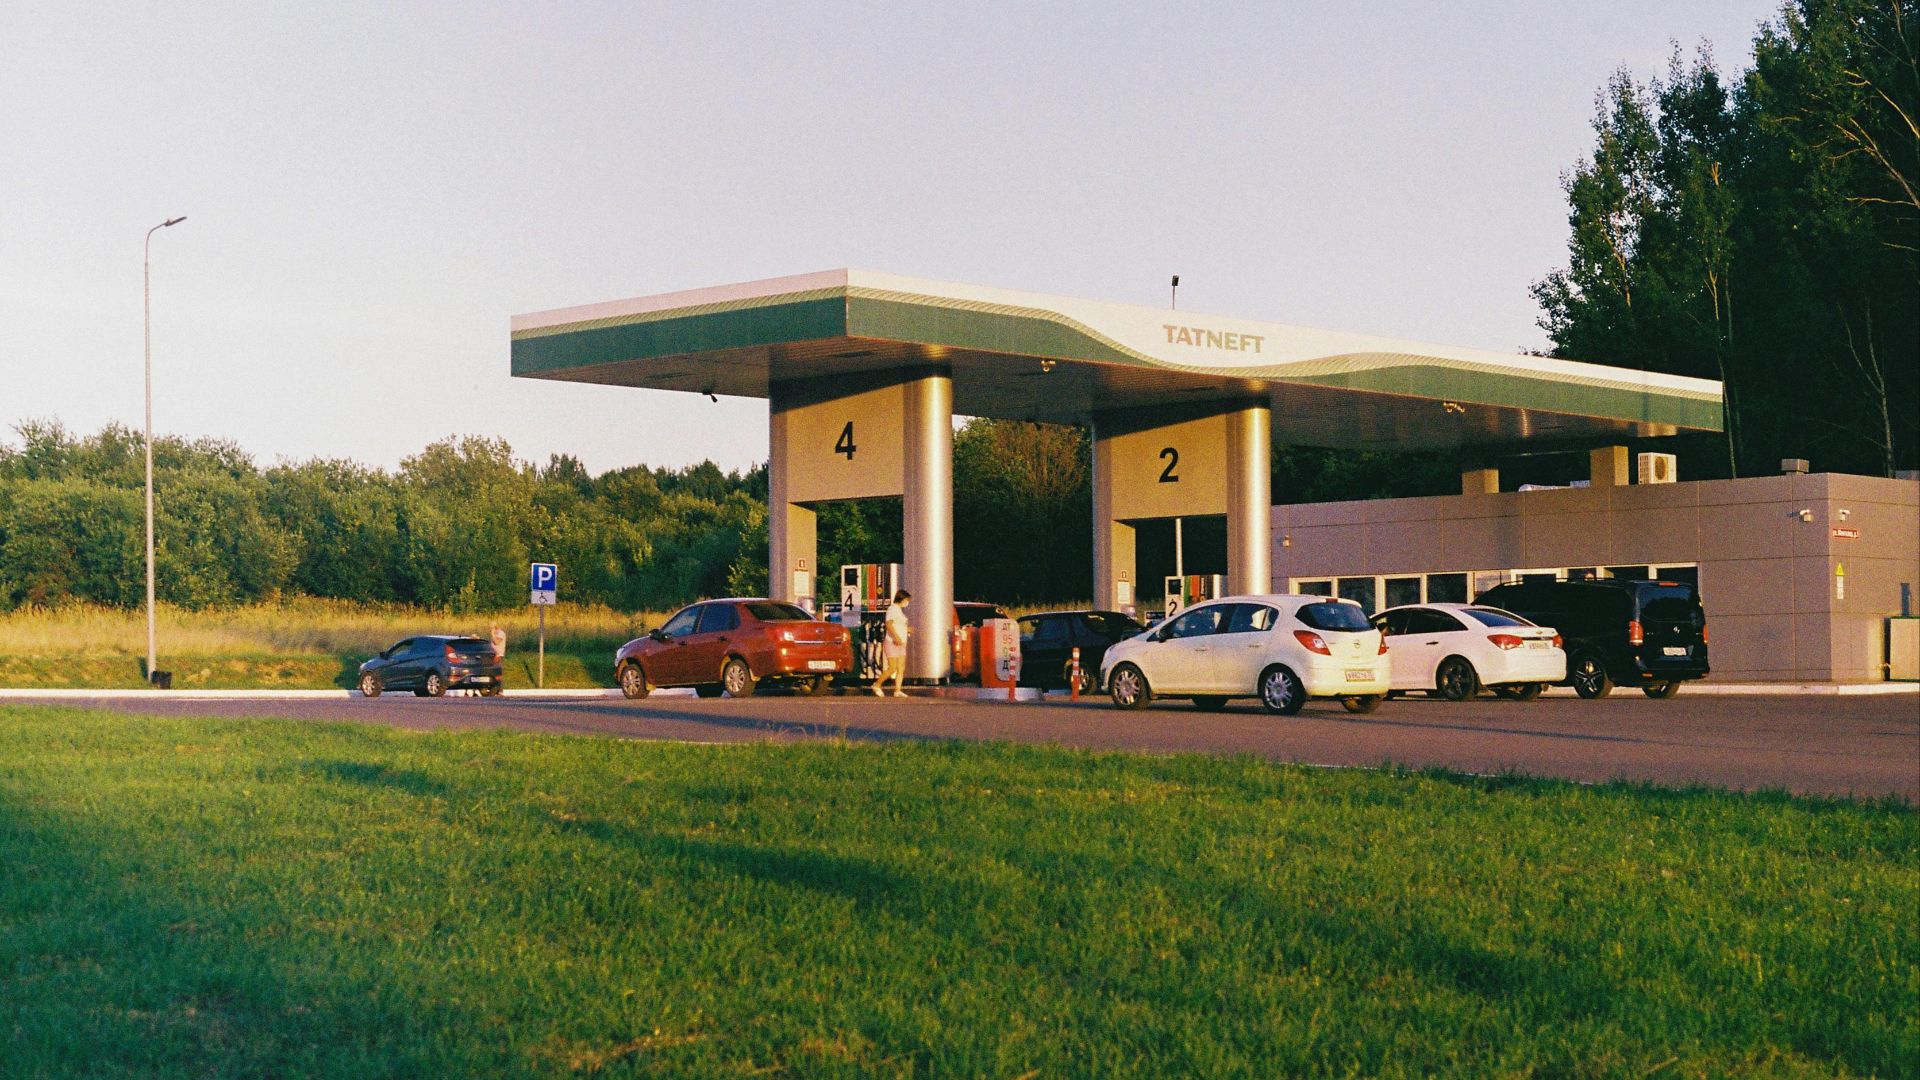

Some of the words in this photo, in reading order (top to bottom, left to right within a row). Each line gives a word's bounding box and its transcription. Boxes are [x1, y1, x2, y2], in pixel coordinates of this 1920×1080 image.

[1163, 324, 1264, 353] TATNEFT
[835, 421, 857, 460] 4
[1159, 447, 1179, 483] 2
[538, 566, 552, 588] P
[844, 593, 854, 611] 4
[1168, 601, 1178, 617] 2
